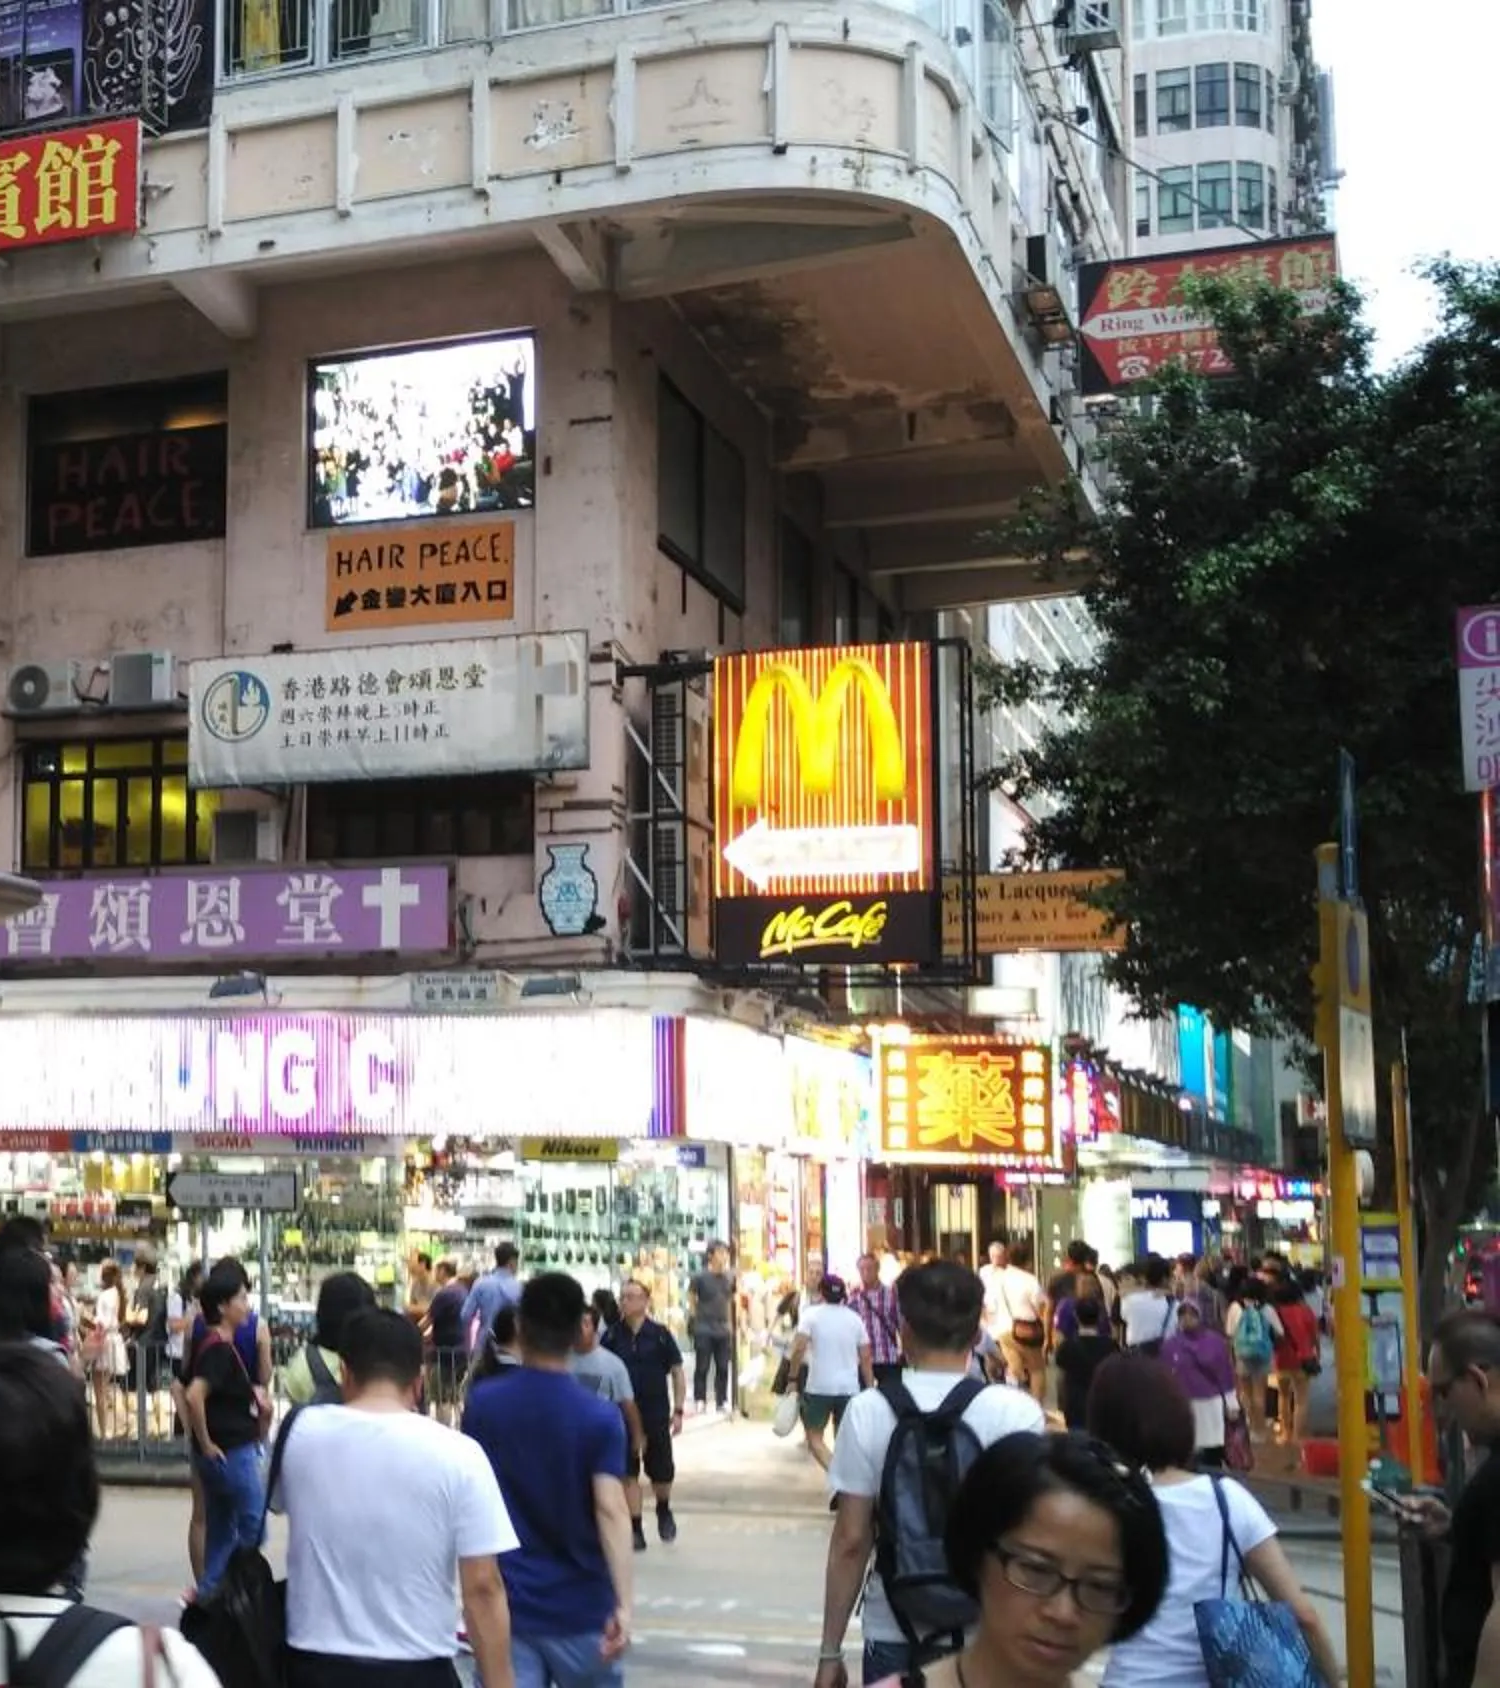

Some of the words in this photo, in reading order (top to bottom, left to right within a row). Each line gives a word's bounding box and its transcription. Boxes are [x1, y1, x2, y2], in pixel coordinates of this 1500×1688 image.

[1100, 317, 1144, 333] Ring
[58, 436, 192, 494] HAIR
[336, 544, 405, 577] HAIR
[194, 1133, 254, 1149] SIGMA
[540, 1140, 601, 1156] Nikon
[1131, 1193, 1170, 1218] ank
